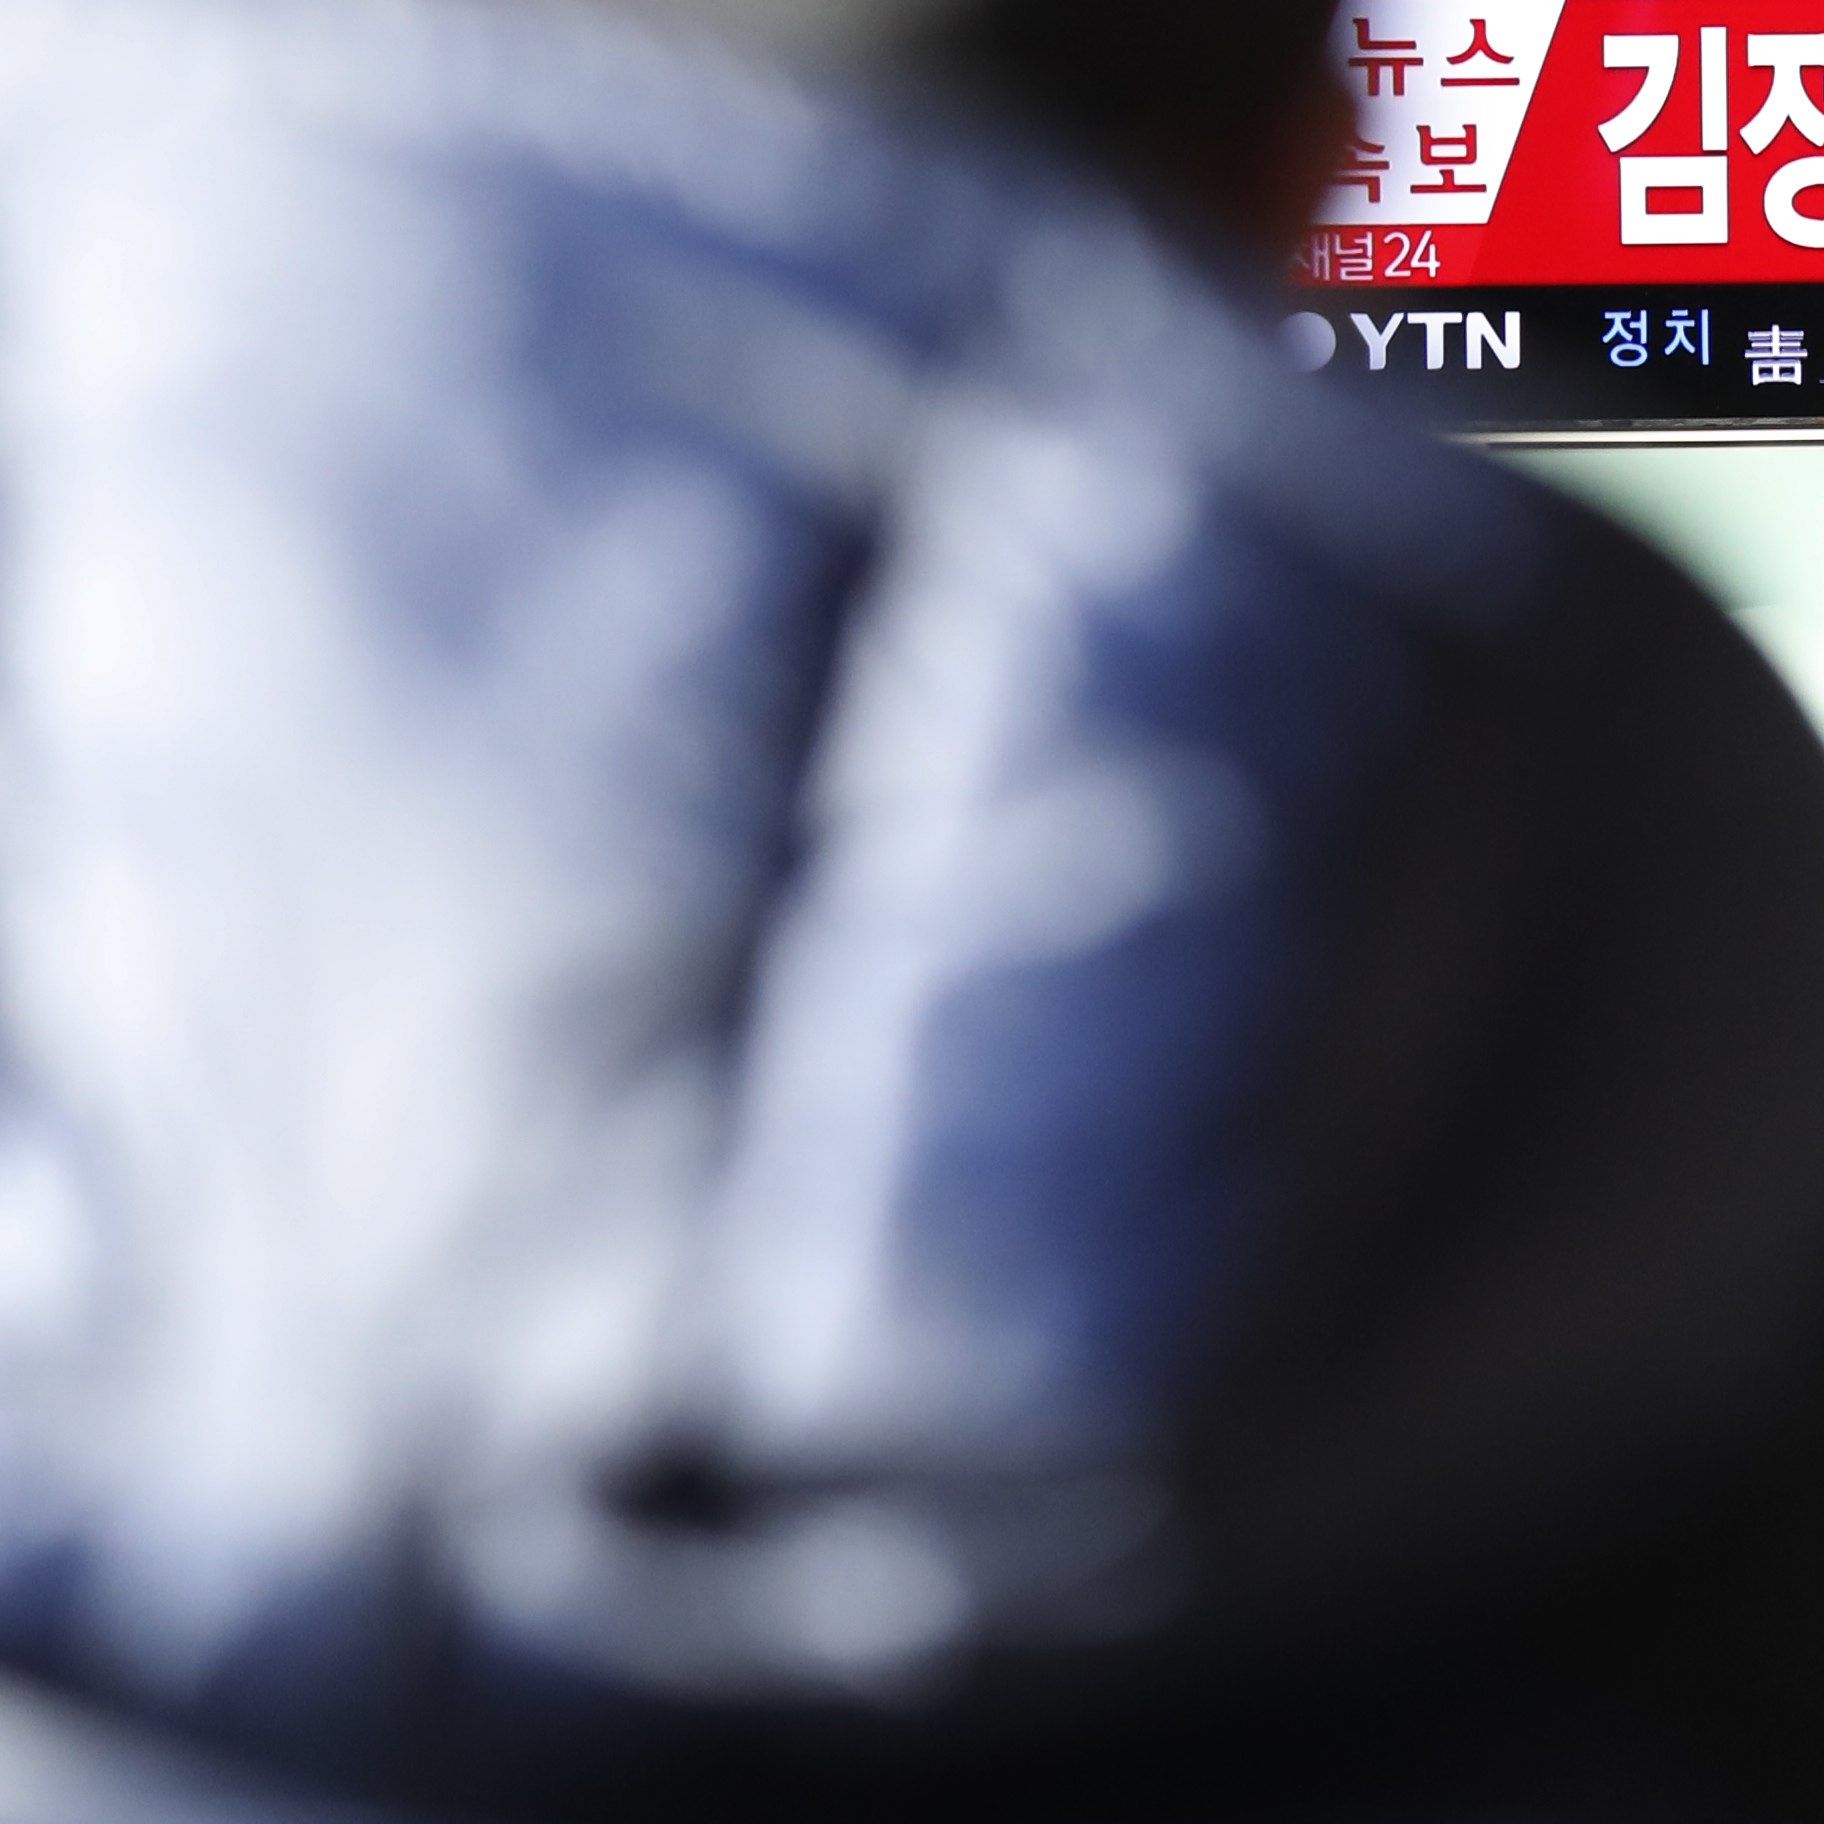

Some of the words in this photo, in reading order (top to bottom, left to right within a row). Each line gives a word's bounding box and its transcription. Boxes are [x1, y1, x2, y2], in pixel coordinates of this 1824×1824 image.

[1348, 18, 1520, 96] 뉴스
[1350, 311, 1521, 371] YTN
[1602, 308, 1710, 367] 정치
